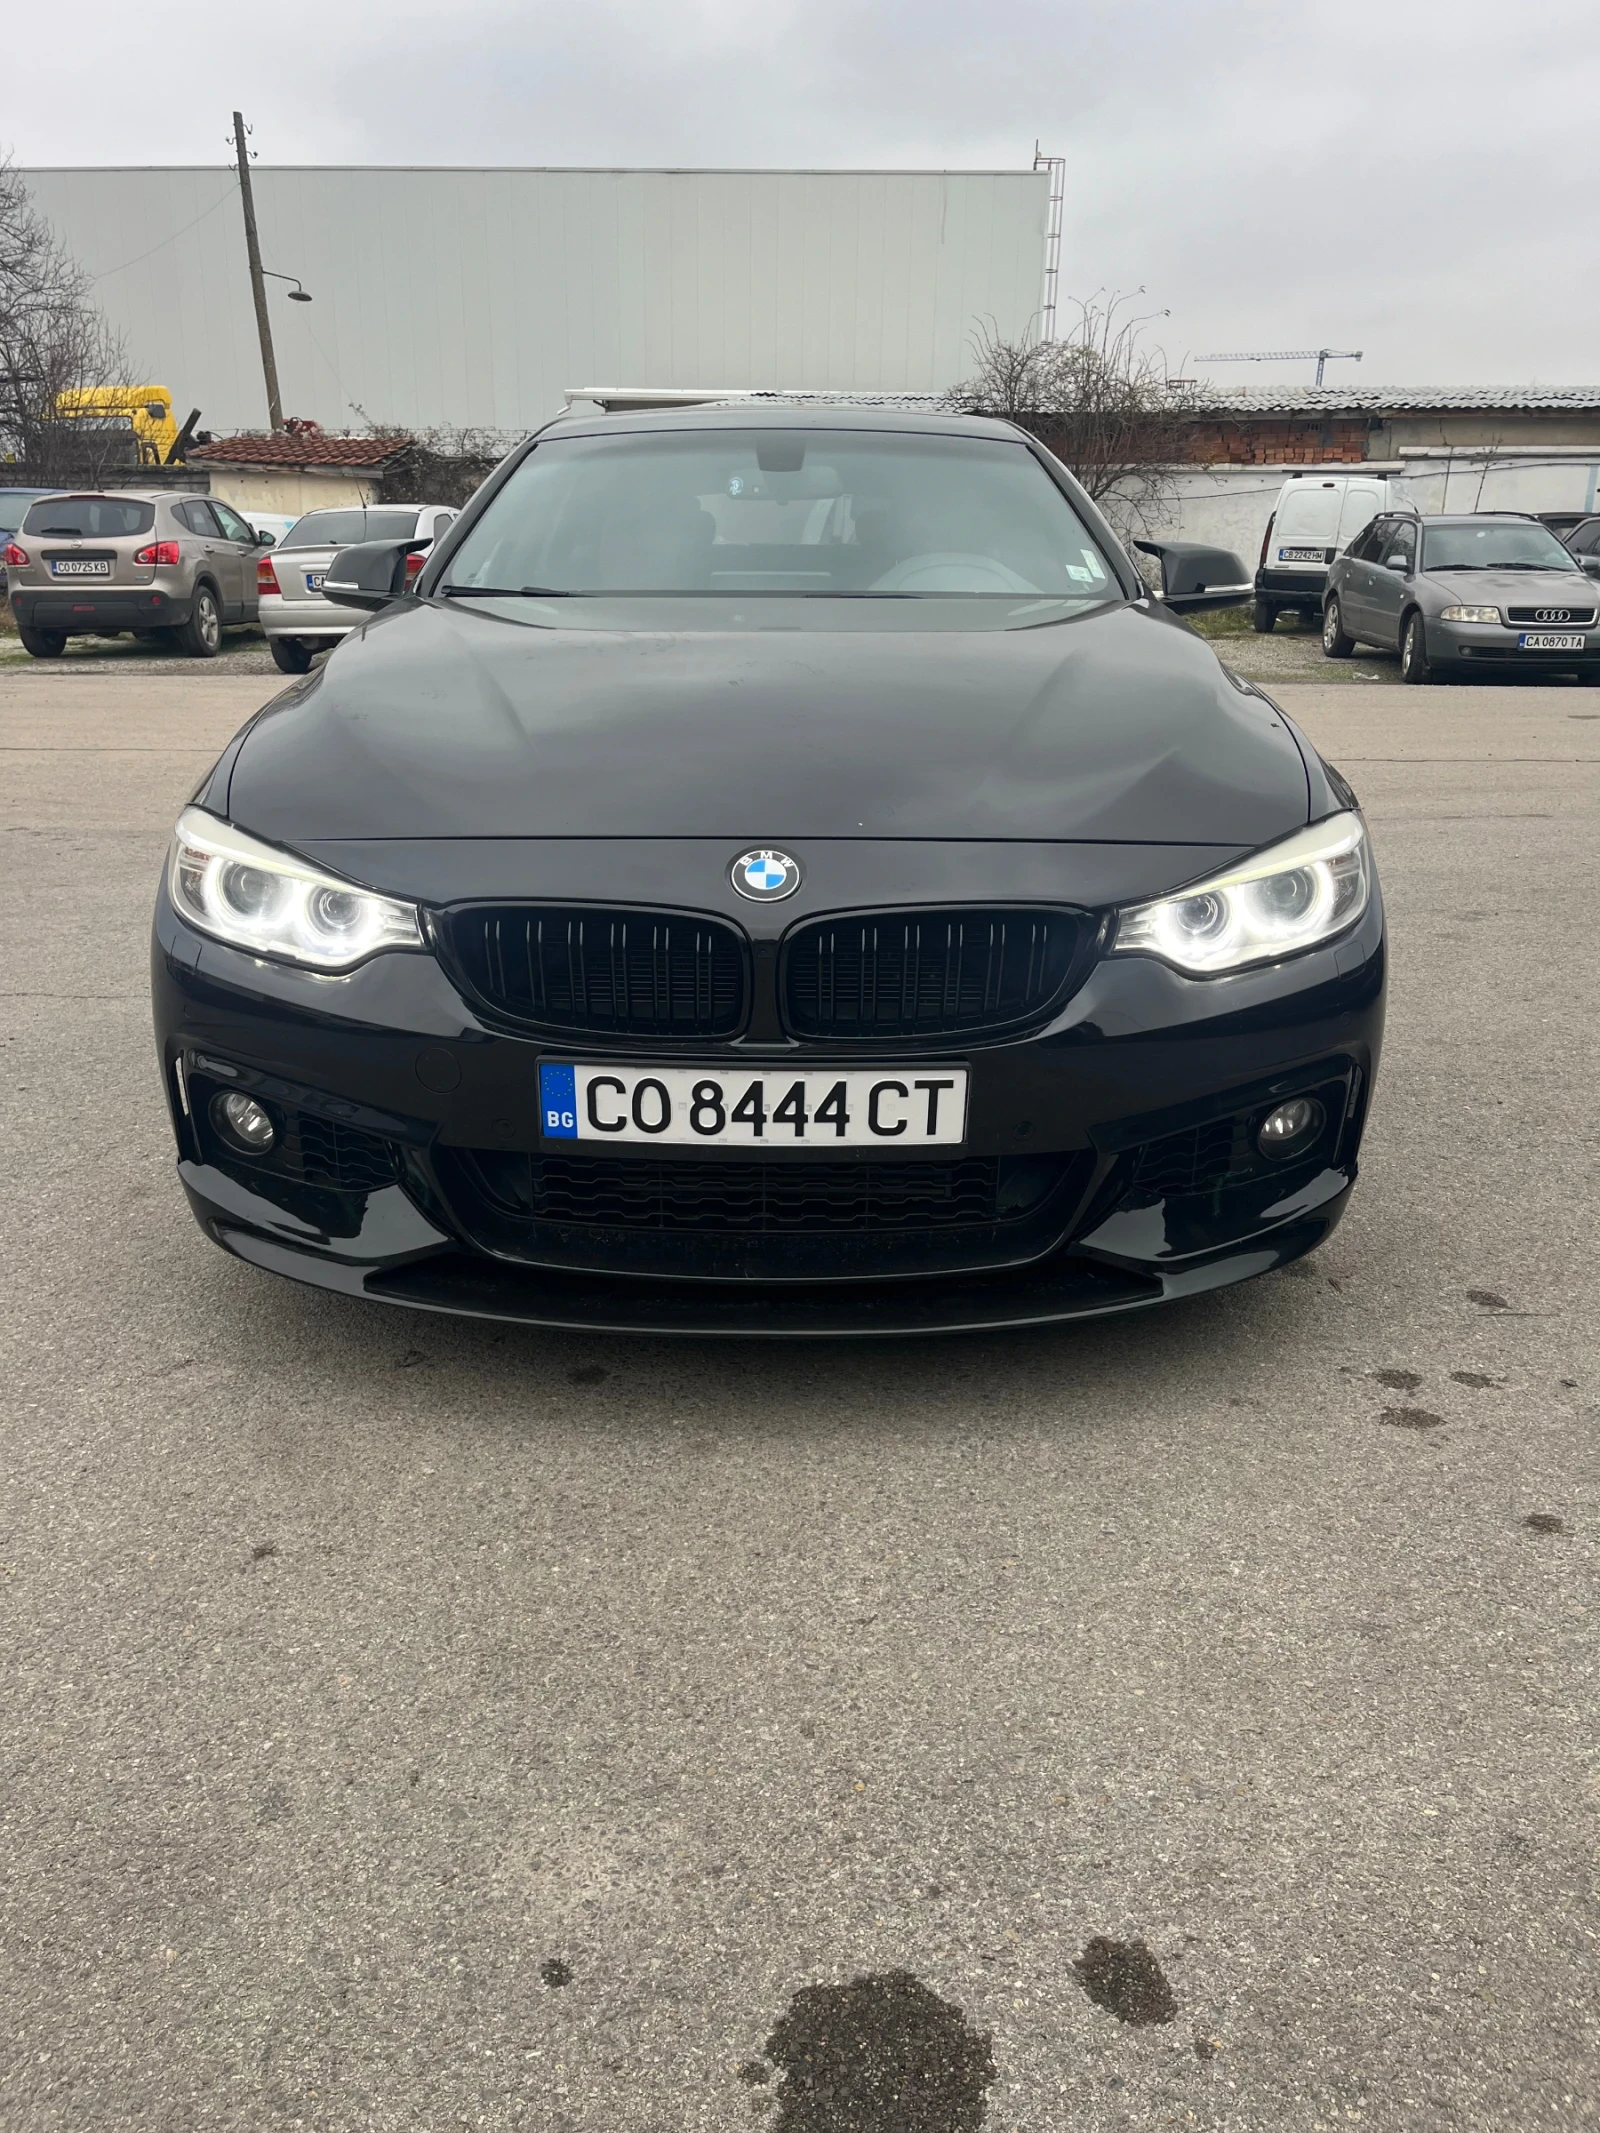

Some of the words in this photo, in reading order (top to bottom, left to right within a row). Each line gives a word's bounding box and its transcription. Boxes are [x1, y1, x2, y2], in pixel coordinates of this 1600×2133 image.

[1294, 551, 1312, 560] 2242
[58, 562, 70, 572] CO
[71, 562, 93, 572] 0725
[94, 562, 107, 572] KB
[1526, 636, 1540, 647] CA
[1542, 636, 1568, 647] 0870
[1570, 636, 1582, 648] TA
[739, 850, 794, 868] BMW
[586, 1075, 672, 1135] CO
[689, 1079, 851, 1138] 8444
[868, 1079, 955, 1137] CT
[546, 1110, 574, 1129] BG
